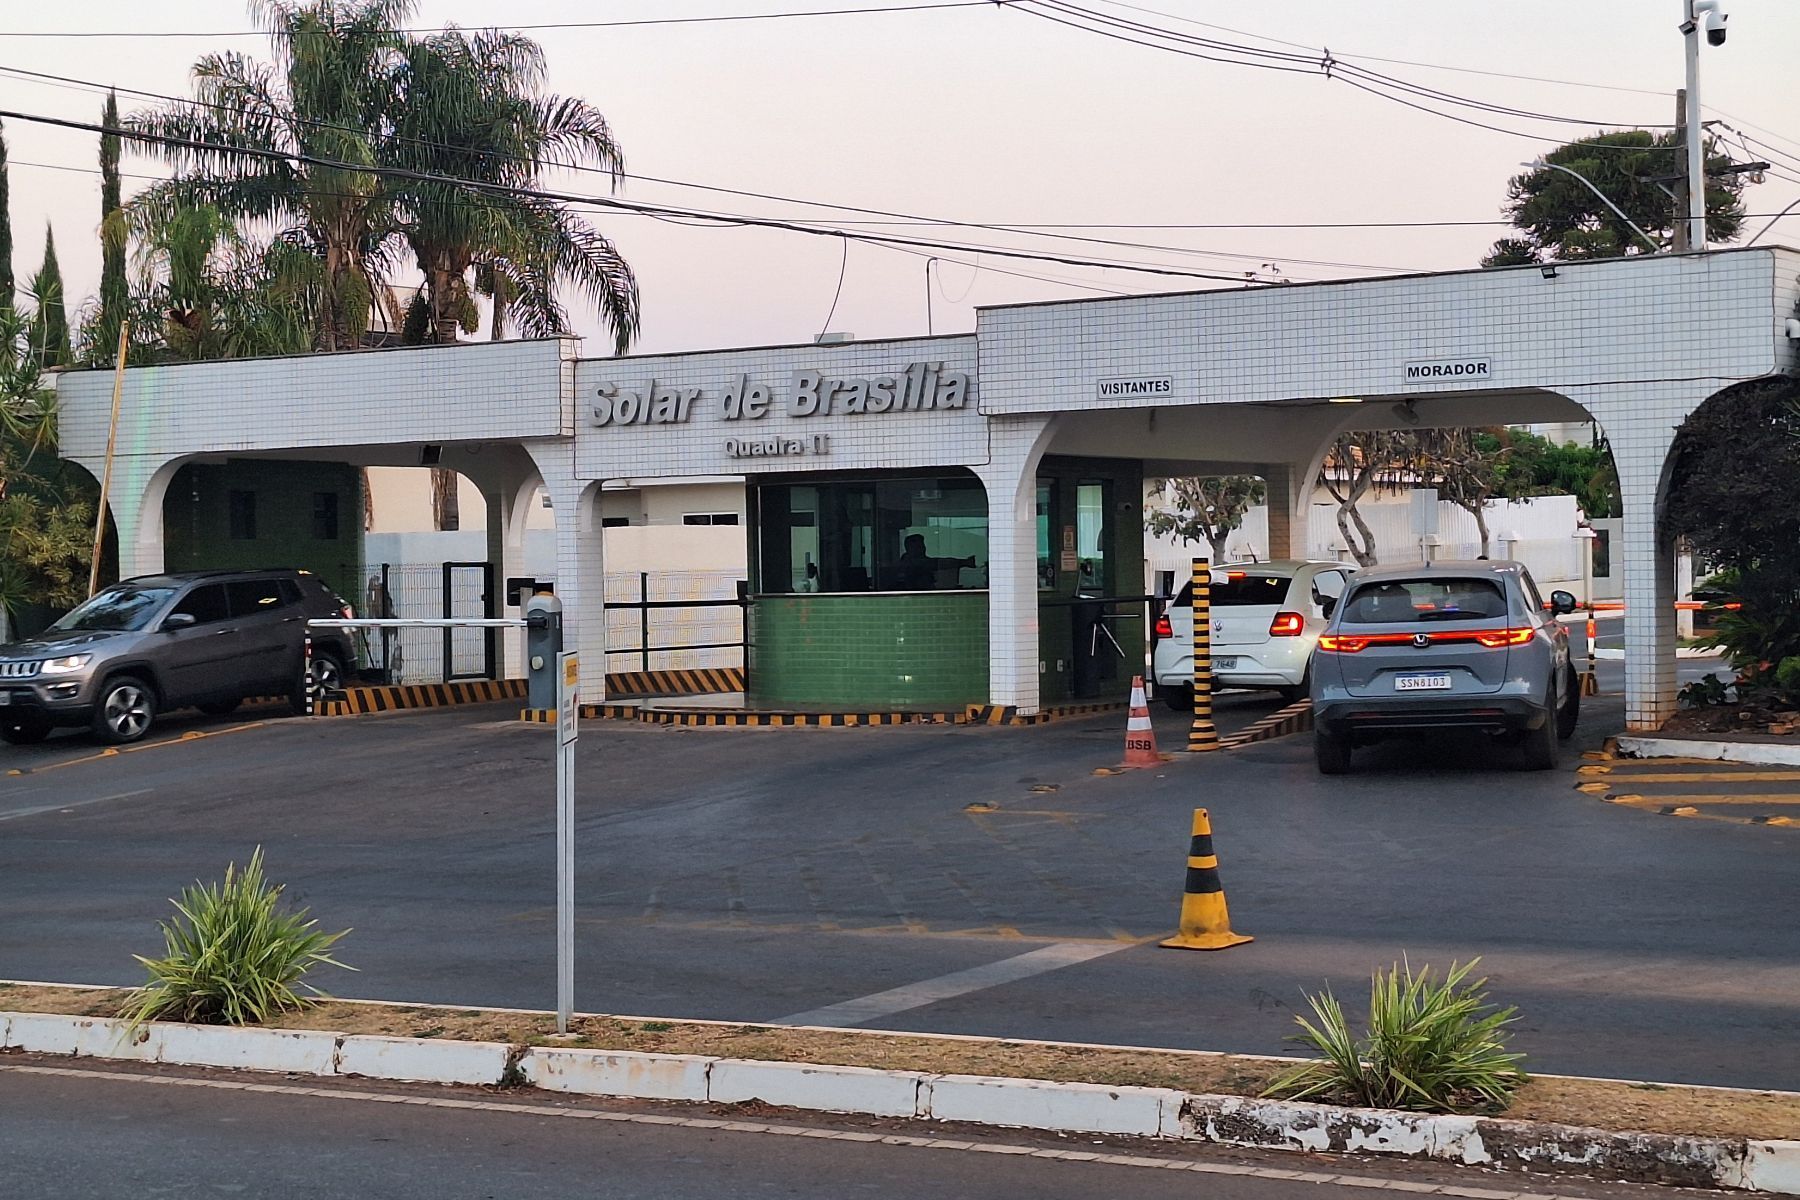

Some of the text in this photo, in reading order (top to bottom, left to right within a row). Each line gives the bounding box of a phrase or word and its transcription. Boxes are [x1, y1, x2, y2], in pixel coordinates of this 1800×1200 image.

[1407, 362, 1488, 378] MORADOR
[590, 361, 969, 427] Solar de Brasília
[1100, 380, 1170, 395] VISITANTES
[723, 436, 804, 458] Quadra
[1127, 739, 1152, 751] BSB
